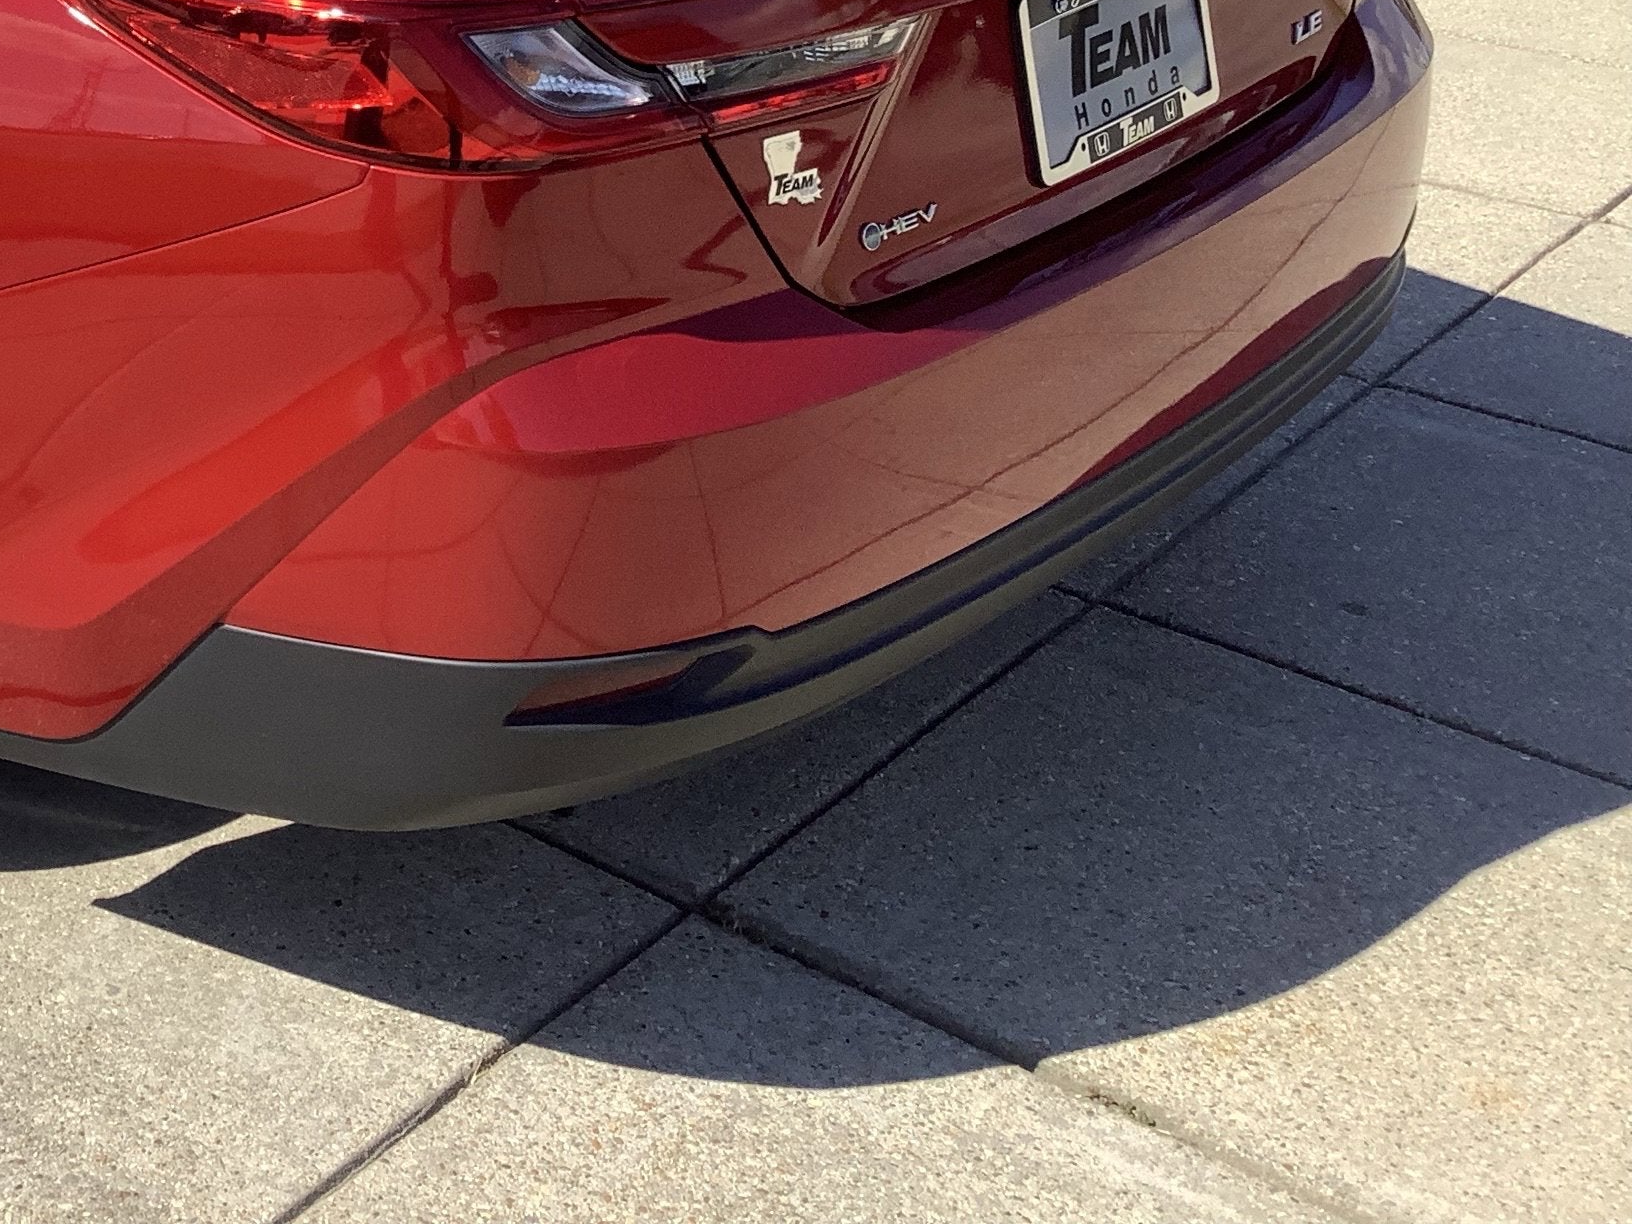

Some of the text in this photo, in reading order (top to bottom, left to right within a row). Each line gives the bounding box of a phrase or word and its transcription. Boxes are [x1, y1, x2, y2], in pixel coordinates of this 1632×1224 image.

[1292, 8, 1323, 45] LE
[1058, 3, 1171, 98] TEAM
[1074, 65, 1180, 130] Honda
[1120, 115, 1155, 147] TEAM
[774, 173, 814, 196] TEAM
